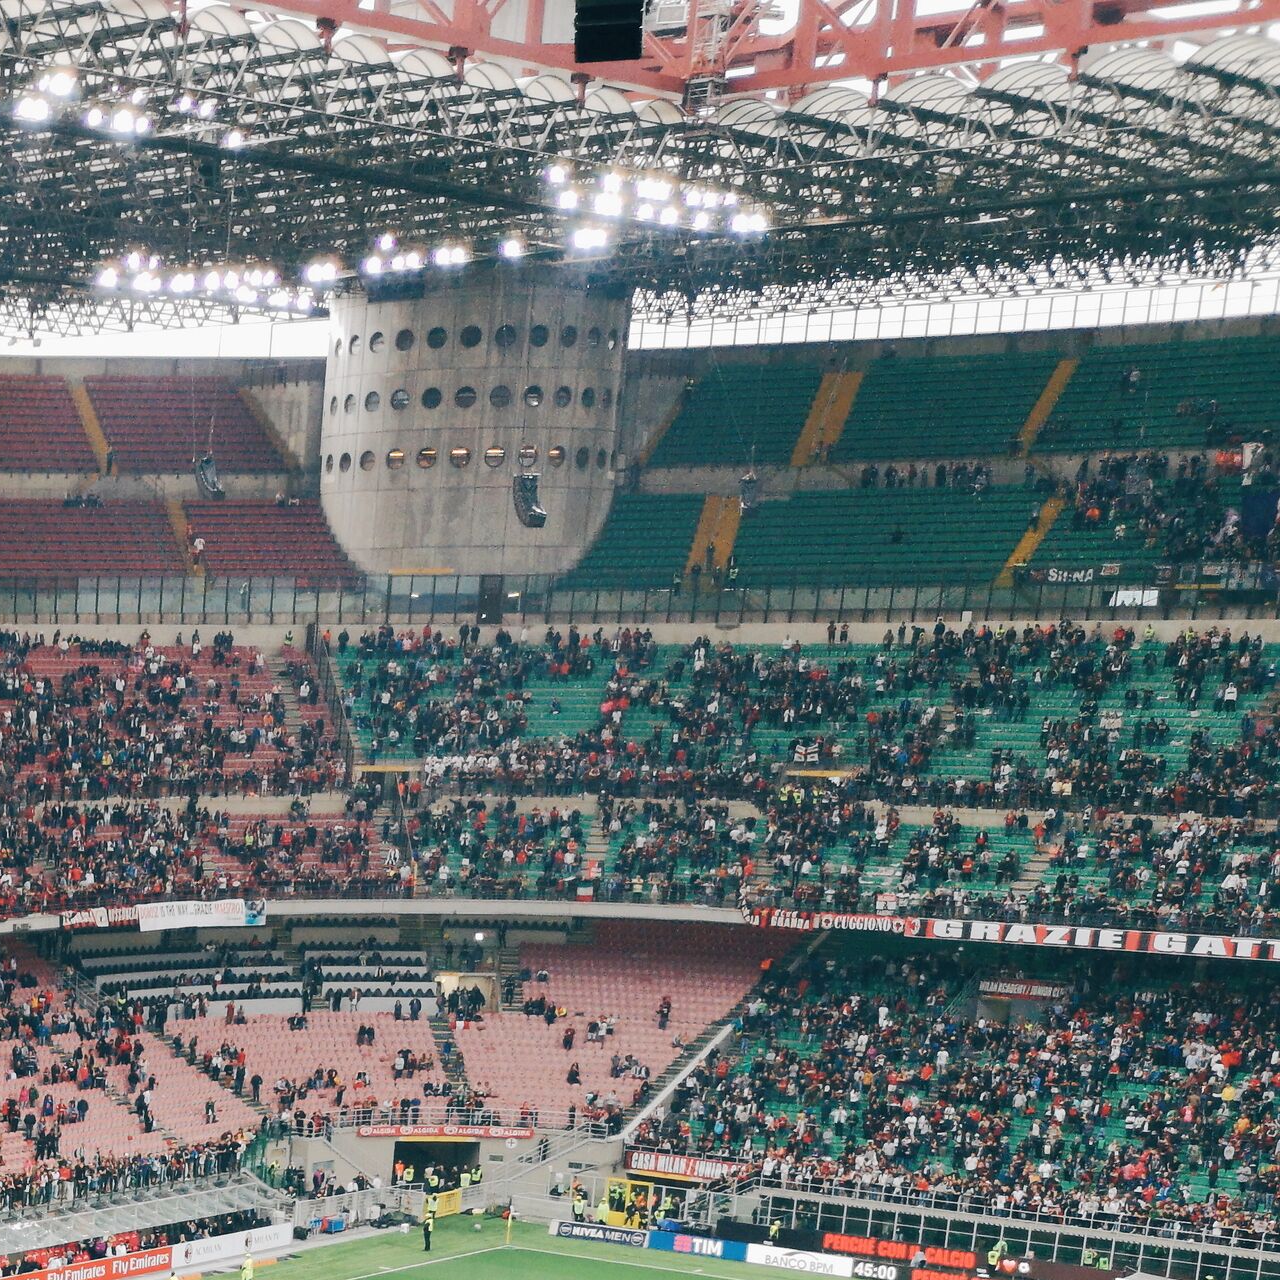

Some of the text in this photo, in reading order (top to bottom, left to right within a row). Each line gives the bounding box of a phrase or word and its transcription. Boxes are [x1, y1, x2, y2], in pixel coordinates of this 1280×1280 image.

[834, 915, 891, 931] CUGGIONO
[932, 919, 1124, 949] GRAZIE
[631, 1152, 656, 1170] CASA
[657, 1155, 687, 1174] MILAN
[572, 1226, 631, 1242] NIVEA MEN
[691, 1238, 723, 1256] TIM
[877, 1240, 906, 1258] CON
[924, 1246, 976, 1268] CALCIO
[112, 1251, 170, 1277] Fly Emirates
[765, 1255, 834, 1274] BANCO BPM
[854, 1261, 897, 1280] 45:00
